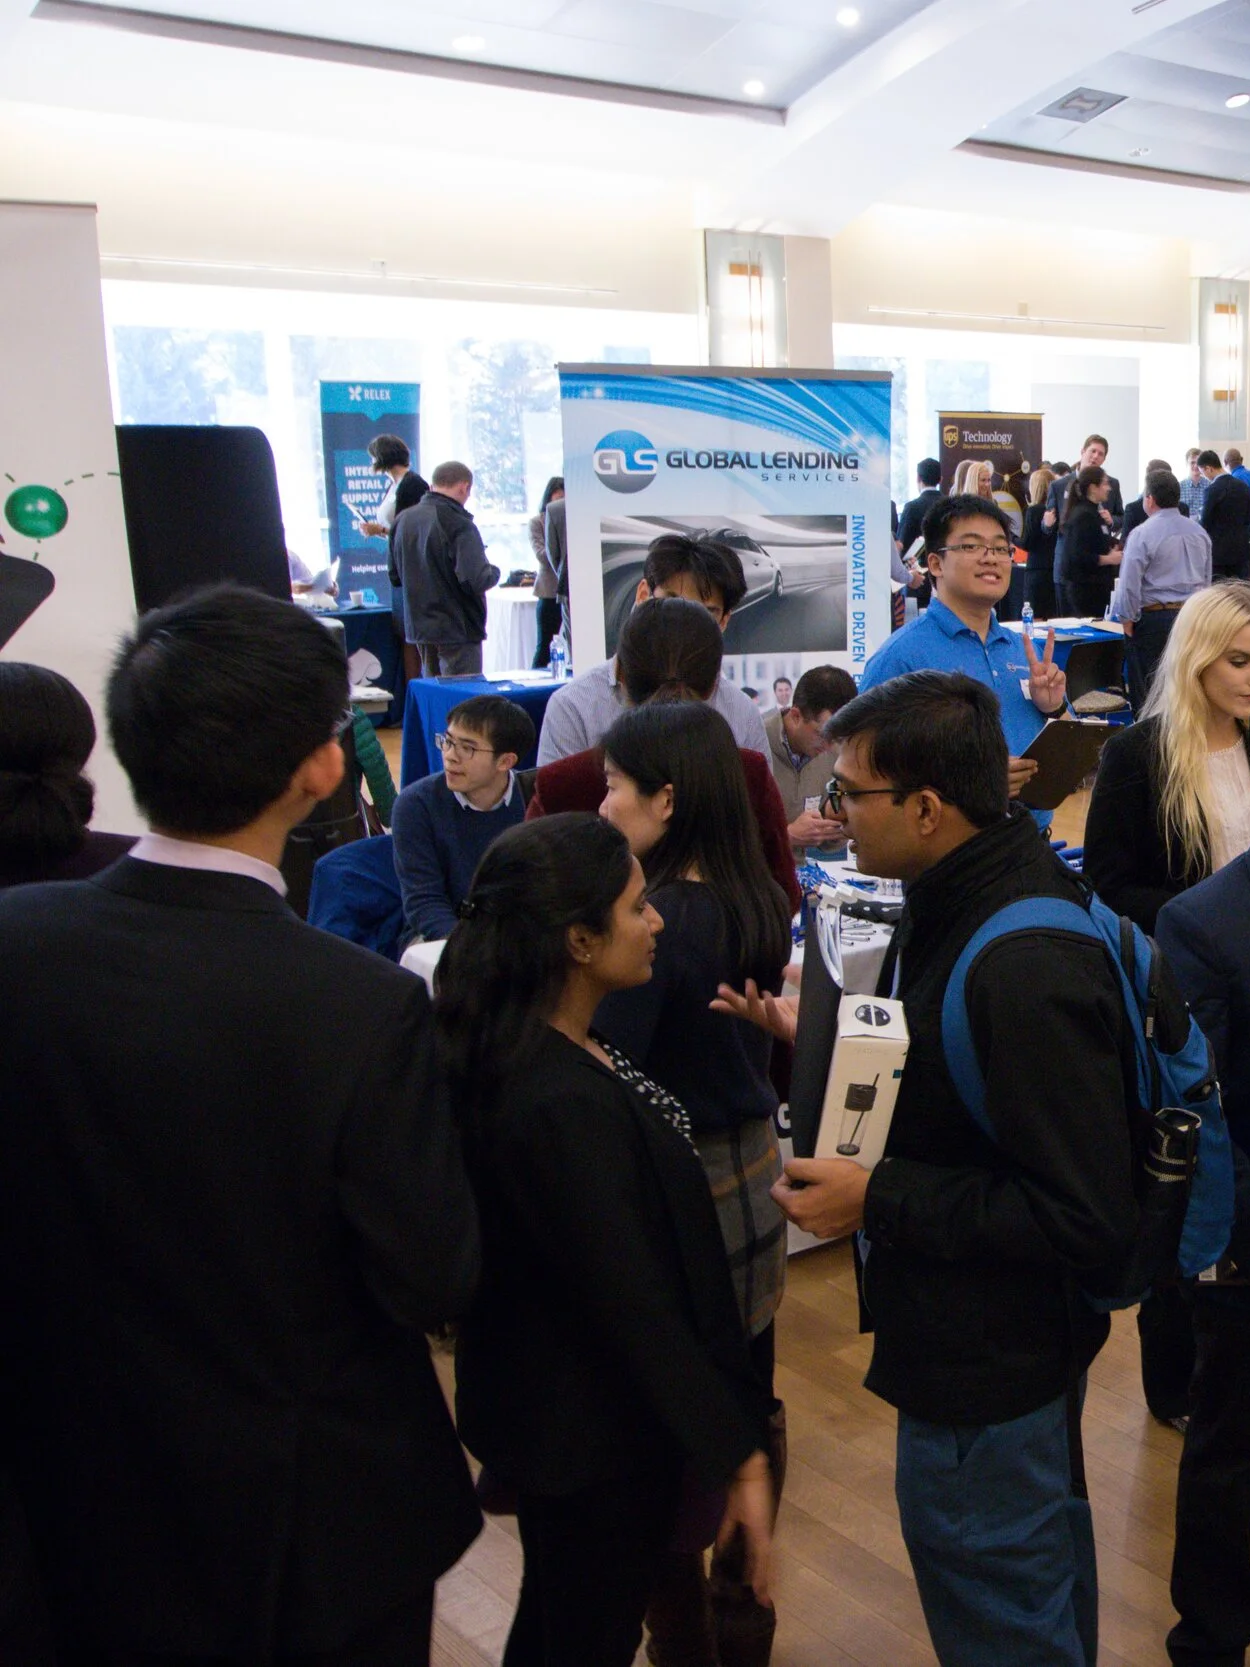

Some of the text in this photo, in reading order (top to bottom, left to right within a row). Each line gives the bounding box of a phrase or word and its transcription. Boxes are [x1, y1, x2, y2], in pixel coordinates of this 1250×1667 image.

[364, 389, 391, 401] RELEX
[962, 430, 1013, 445] Technology
[592, 448, 660, 476] GLS
[665, 449, 859, 471] GLOBAL LENDING
[761, 471, 860, 483] SERVICES
[347, 479, 383, 491] RETAIL
[342, 493, 380, 504] SUPPLY
[852, 515, 866, 601] INNOVATIVE
[351, 564, 377, 575] Helping
[852, 611, 866, 663] DRIVEN
